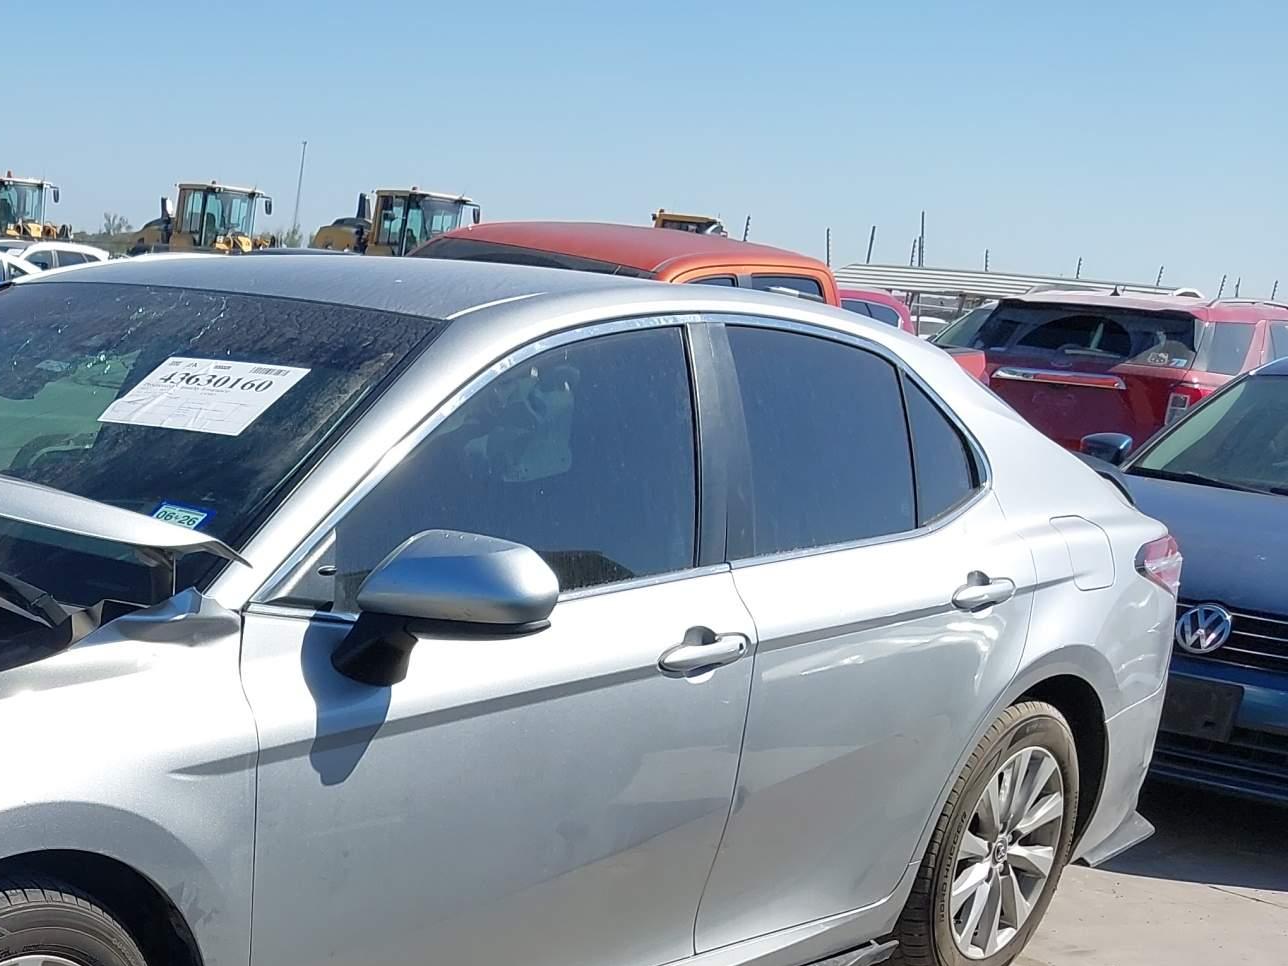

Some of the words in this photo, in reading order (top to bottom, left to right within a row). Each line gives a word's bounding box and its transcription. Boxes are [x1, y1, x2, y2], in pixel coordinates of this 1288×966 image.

[159, 371, 274, 393] 43630160
[156, 510, 176, 521] 06
[177, 515, 199, 526] 26
[1176, 603, 1231, 654] VW
